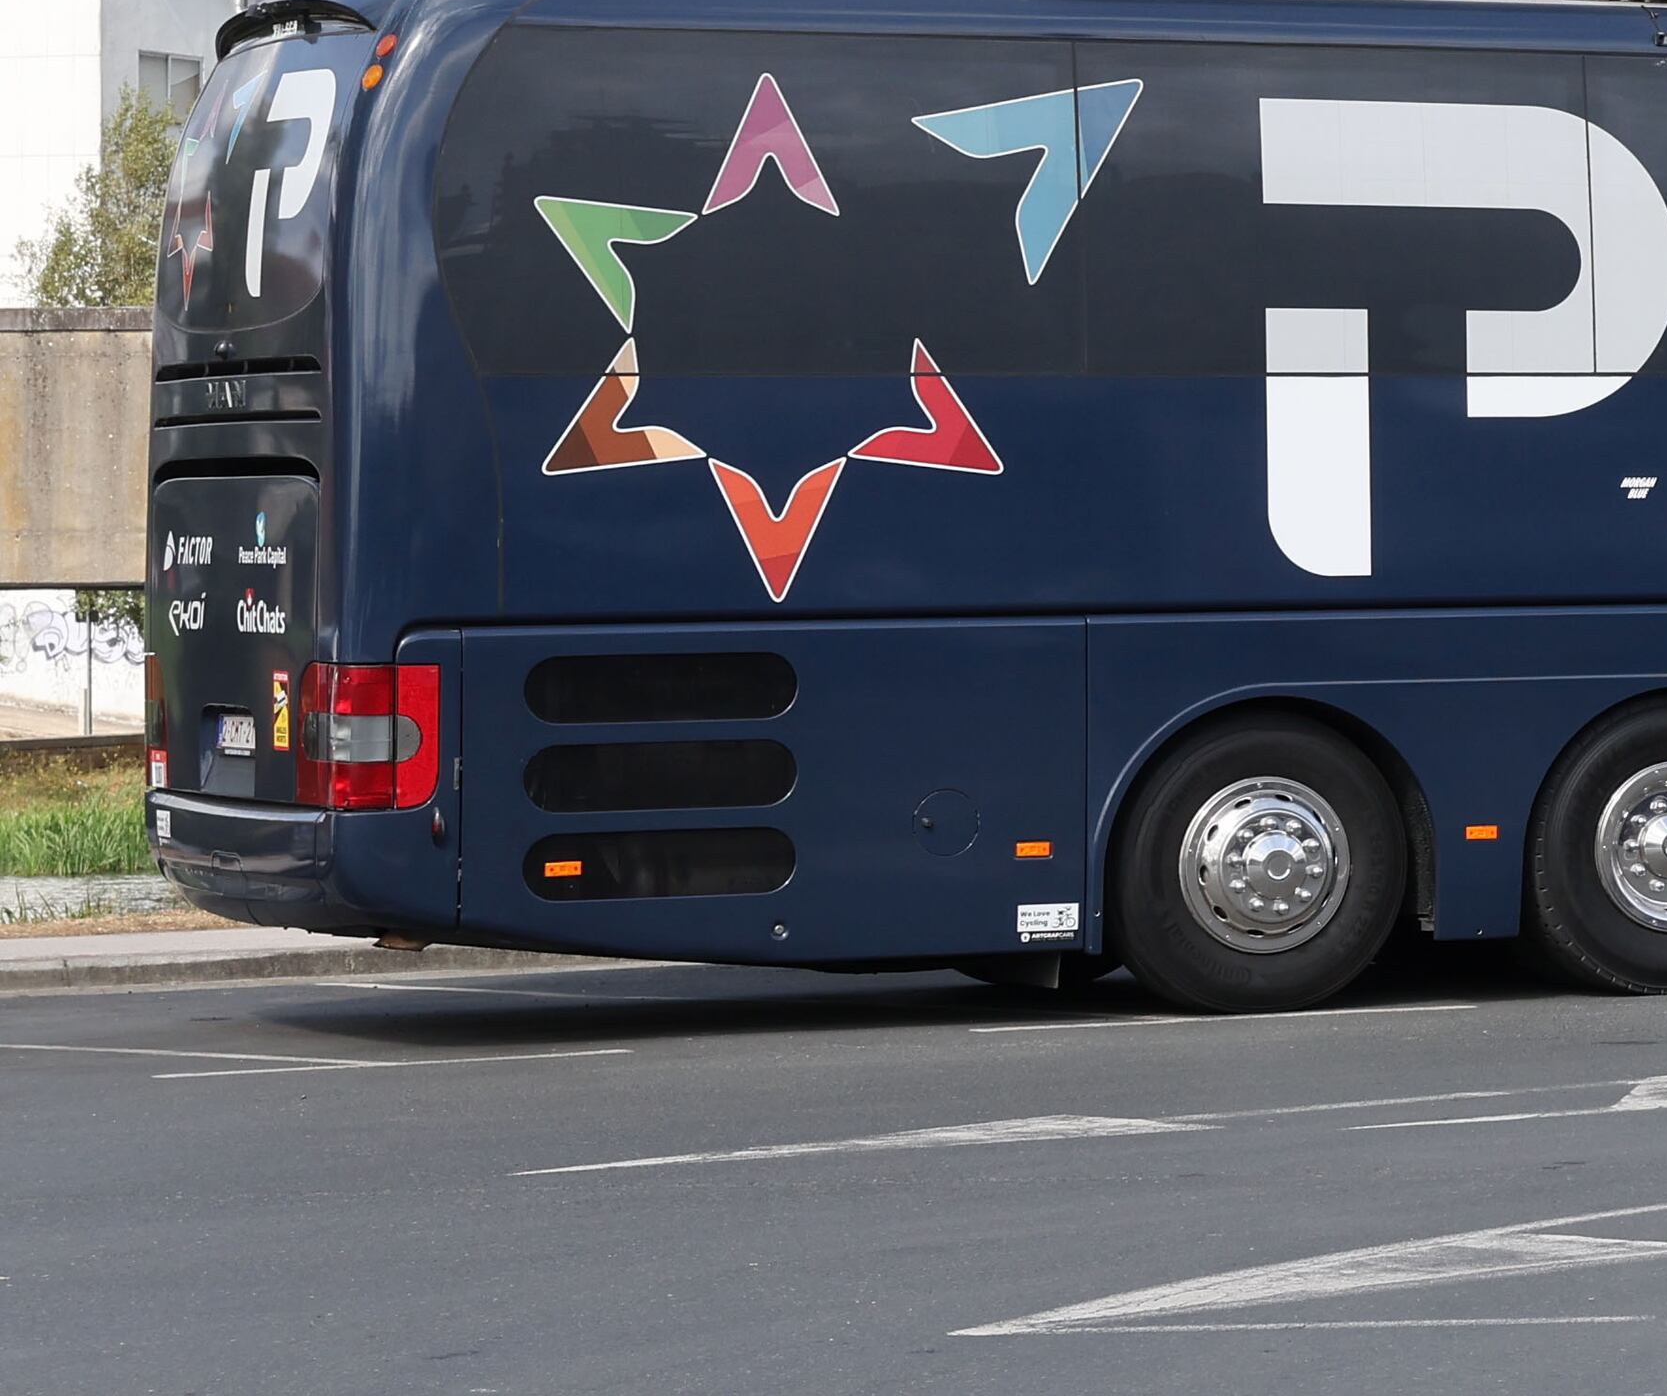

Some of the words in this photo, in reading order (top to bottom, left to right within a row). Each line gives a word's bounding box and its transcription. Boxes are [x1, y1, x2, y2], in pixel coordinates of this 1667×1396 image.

[1620, 477, 1658, 488] MORGAN
[1627, 488, 1650, 499] BLUE
[176, 536, 213, 566] FACTOR
[238, 546, 254, 564] Peace
[254, 546, 267, 564] Park
[267, 546, 287, 569] Capital
